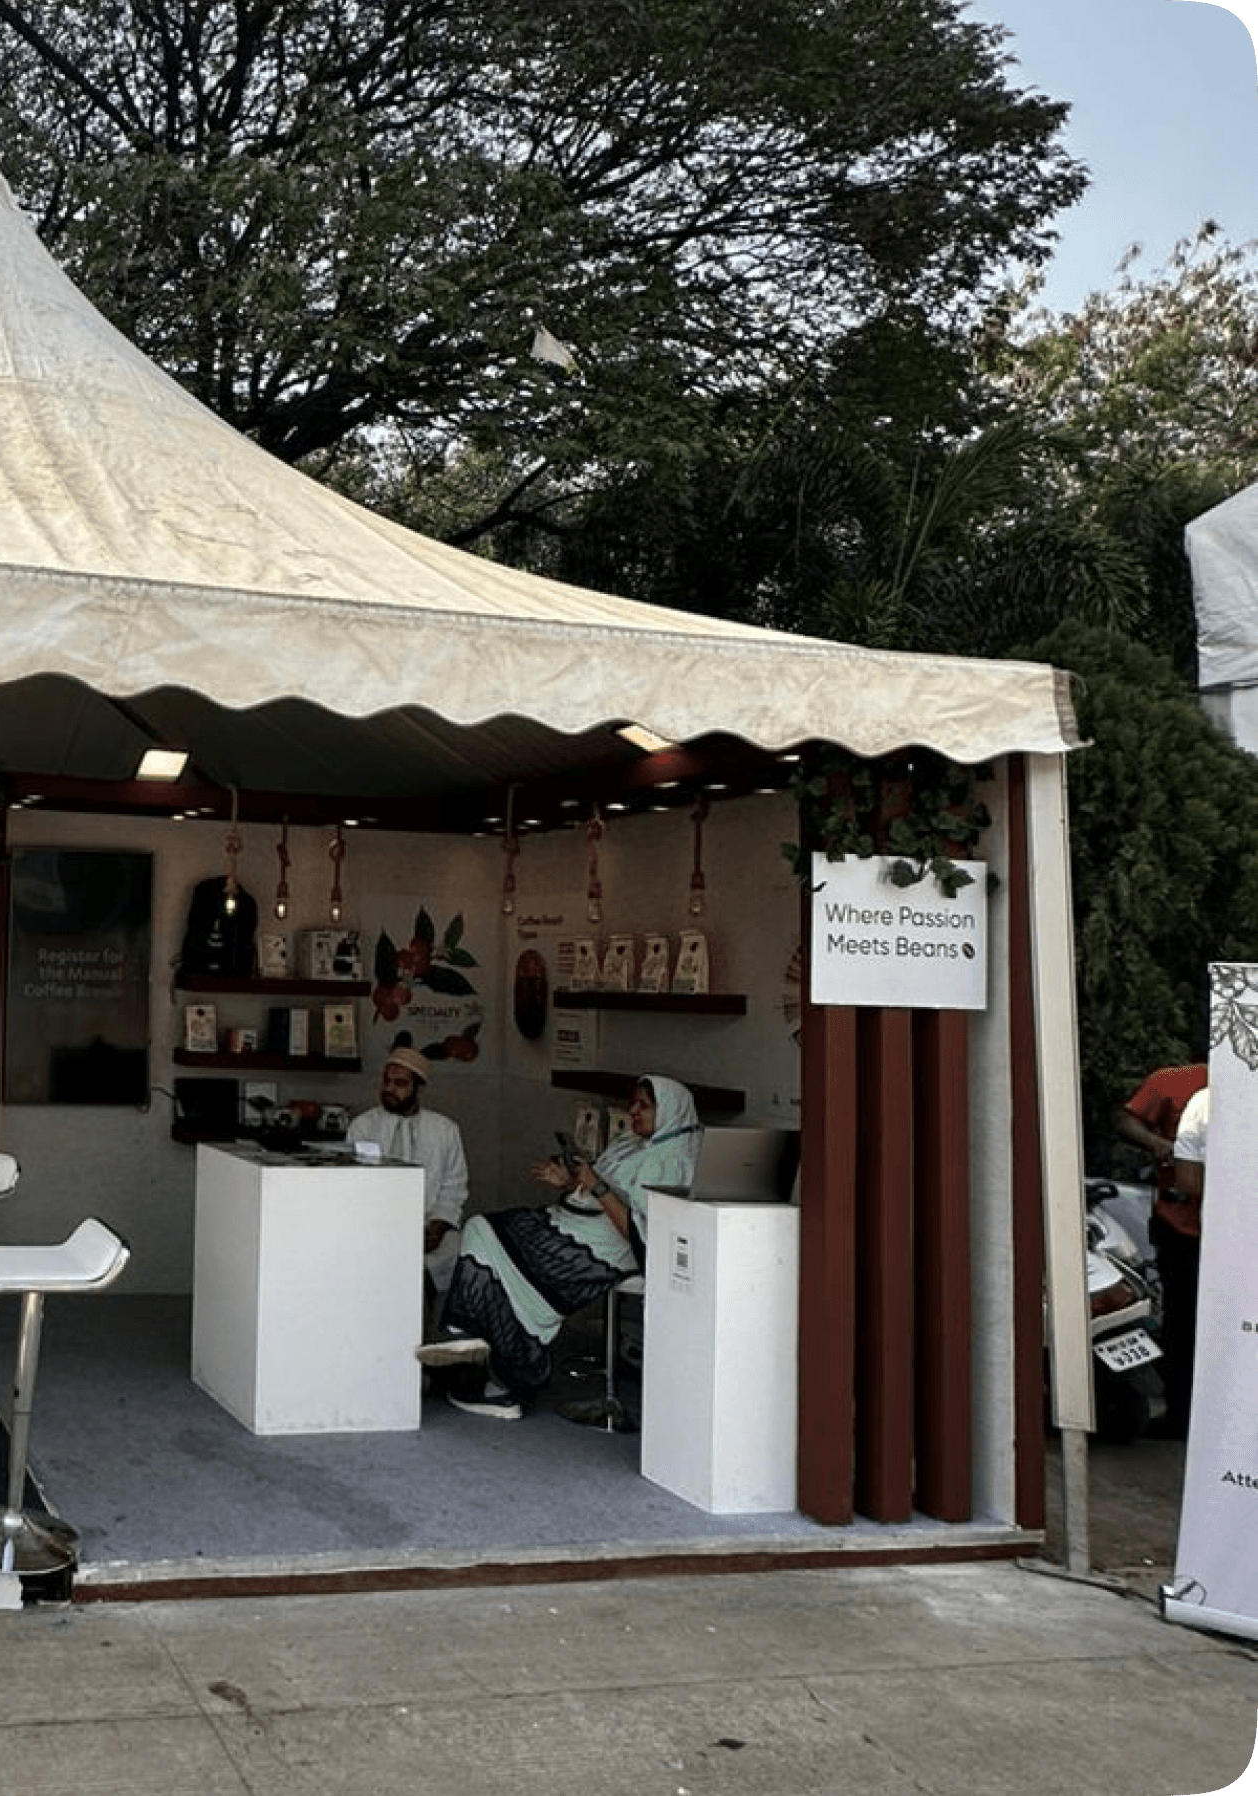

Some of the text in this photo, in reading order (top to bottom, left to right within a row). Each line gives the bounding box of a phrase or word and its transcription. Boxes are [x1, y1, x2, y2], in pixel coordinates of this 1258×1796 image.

[825, 903, 975, 929] Where Passion
[827, 934, 958, 958] Meets Beans
[37, 947, 101, 965] Register
[38, 965, 123, 981] the Manual
[23, 982, 74, 998] Coffee
